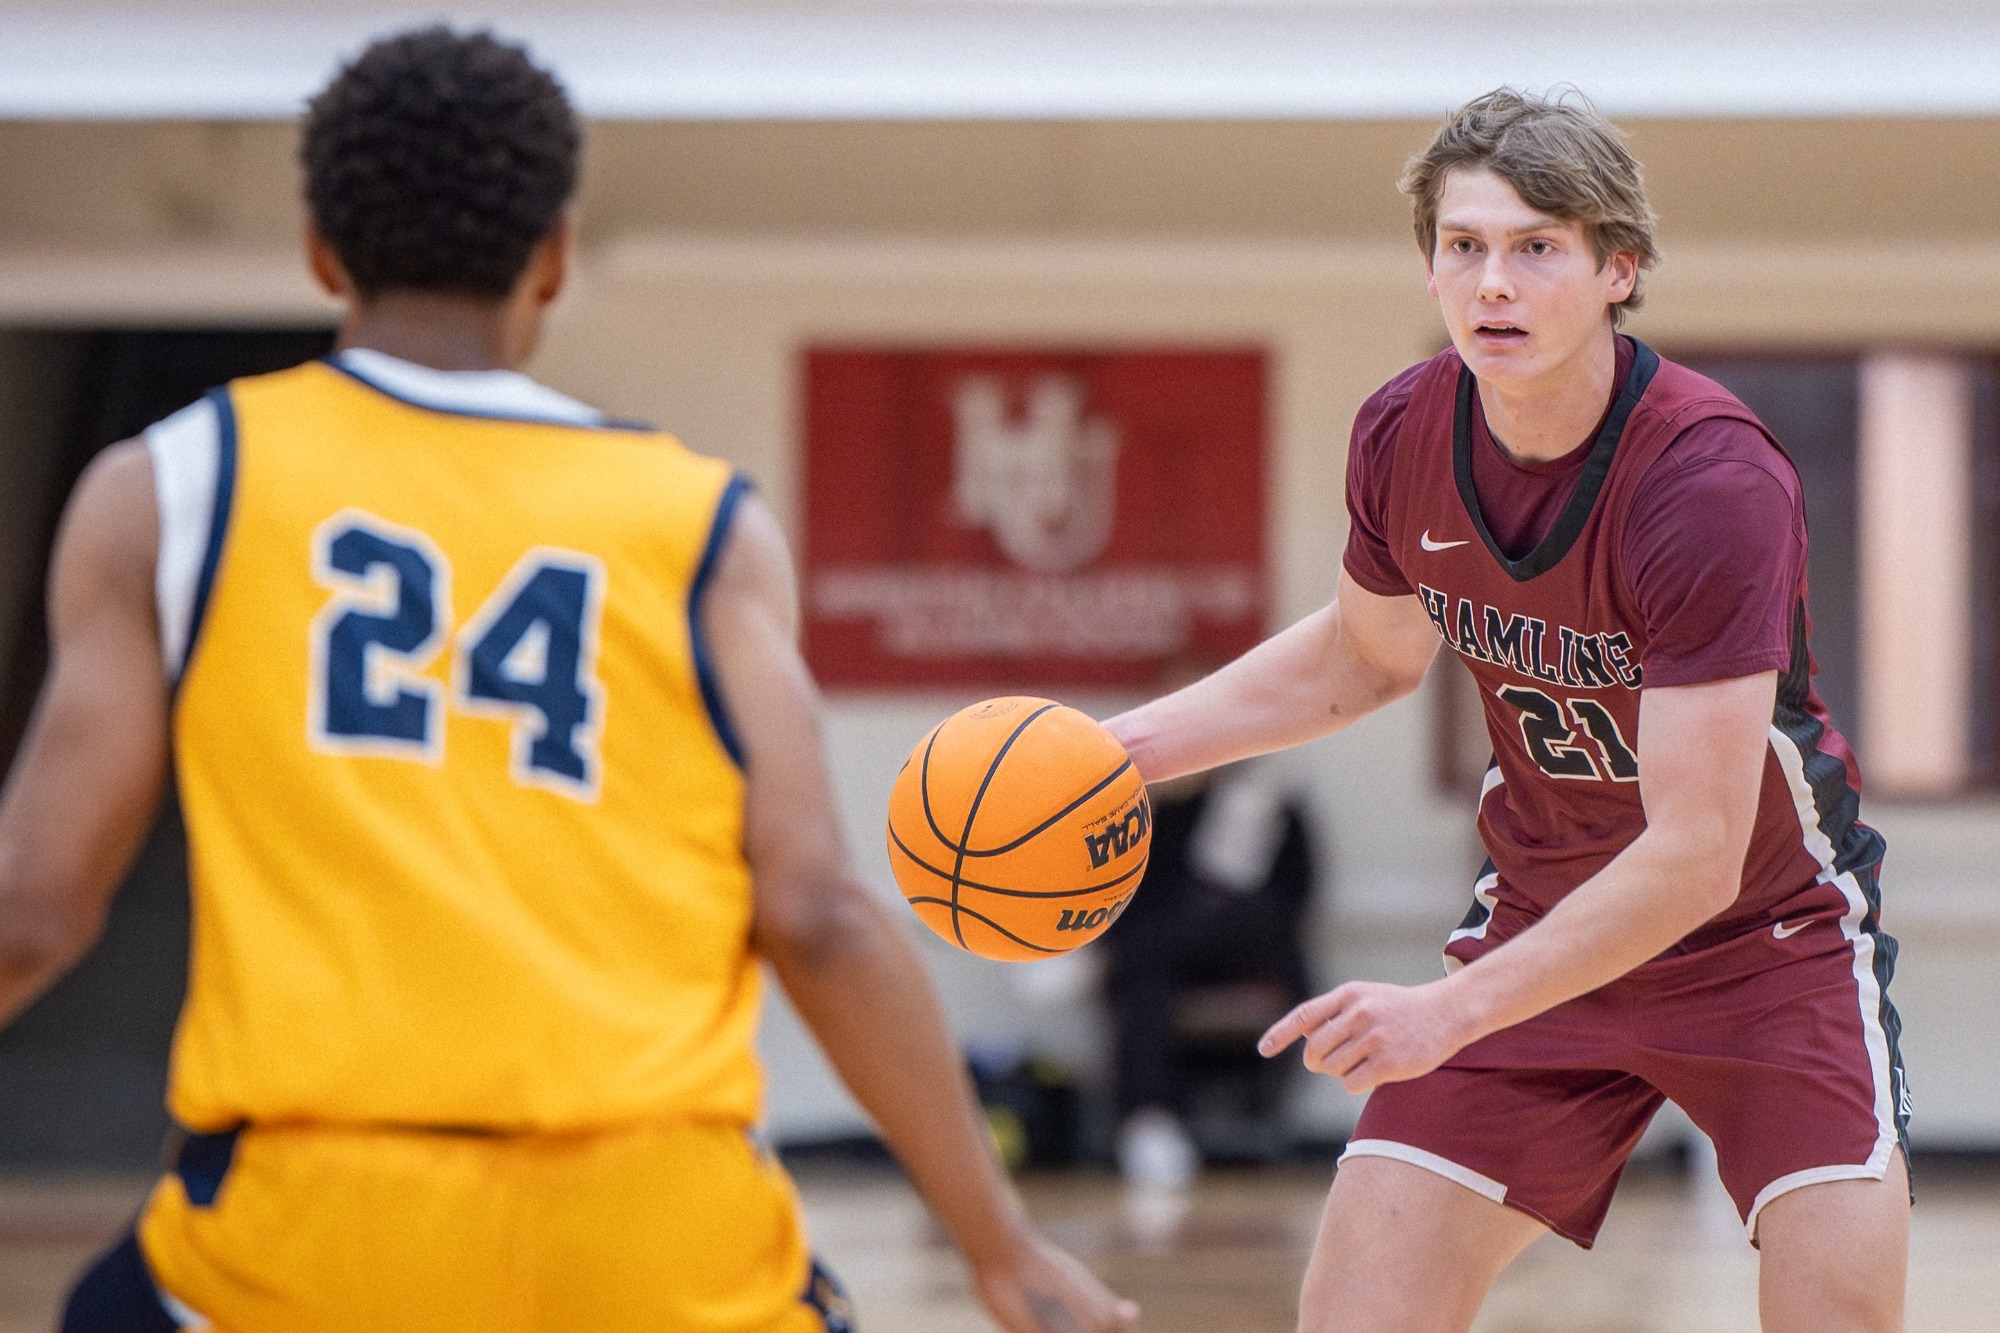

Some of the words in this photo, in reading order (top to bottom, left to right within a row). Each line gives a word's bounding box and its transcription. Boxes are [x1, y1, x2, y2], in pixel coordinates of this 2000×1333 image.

[307, 508, 608, 805] 24
[1418, 582, 1643, 690] HAMLINE
[1496, 683, 1639, 782] 21
[1084, 790, 1151, 870] NCAA
